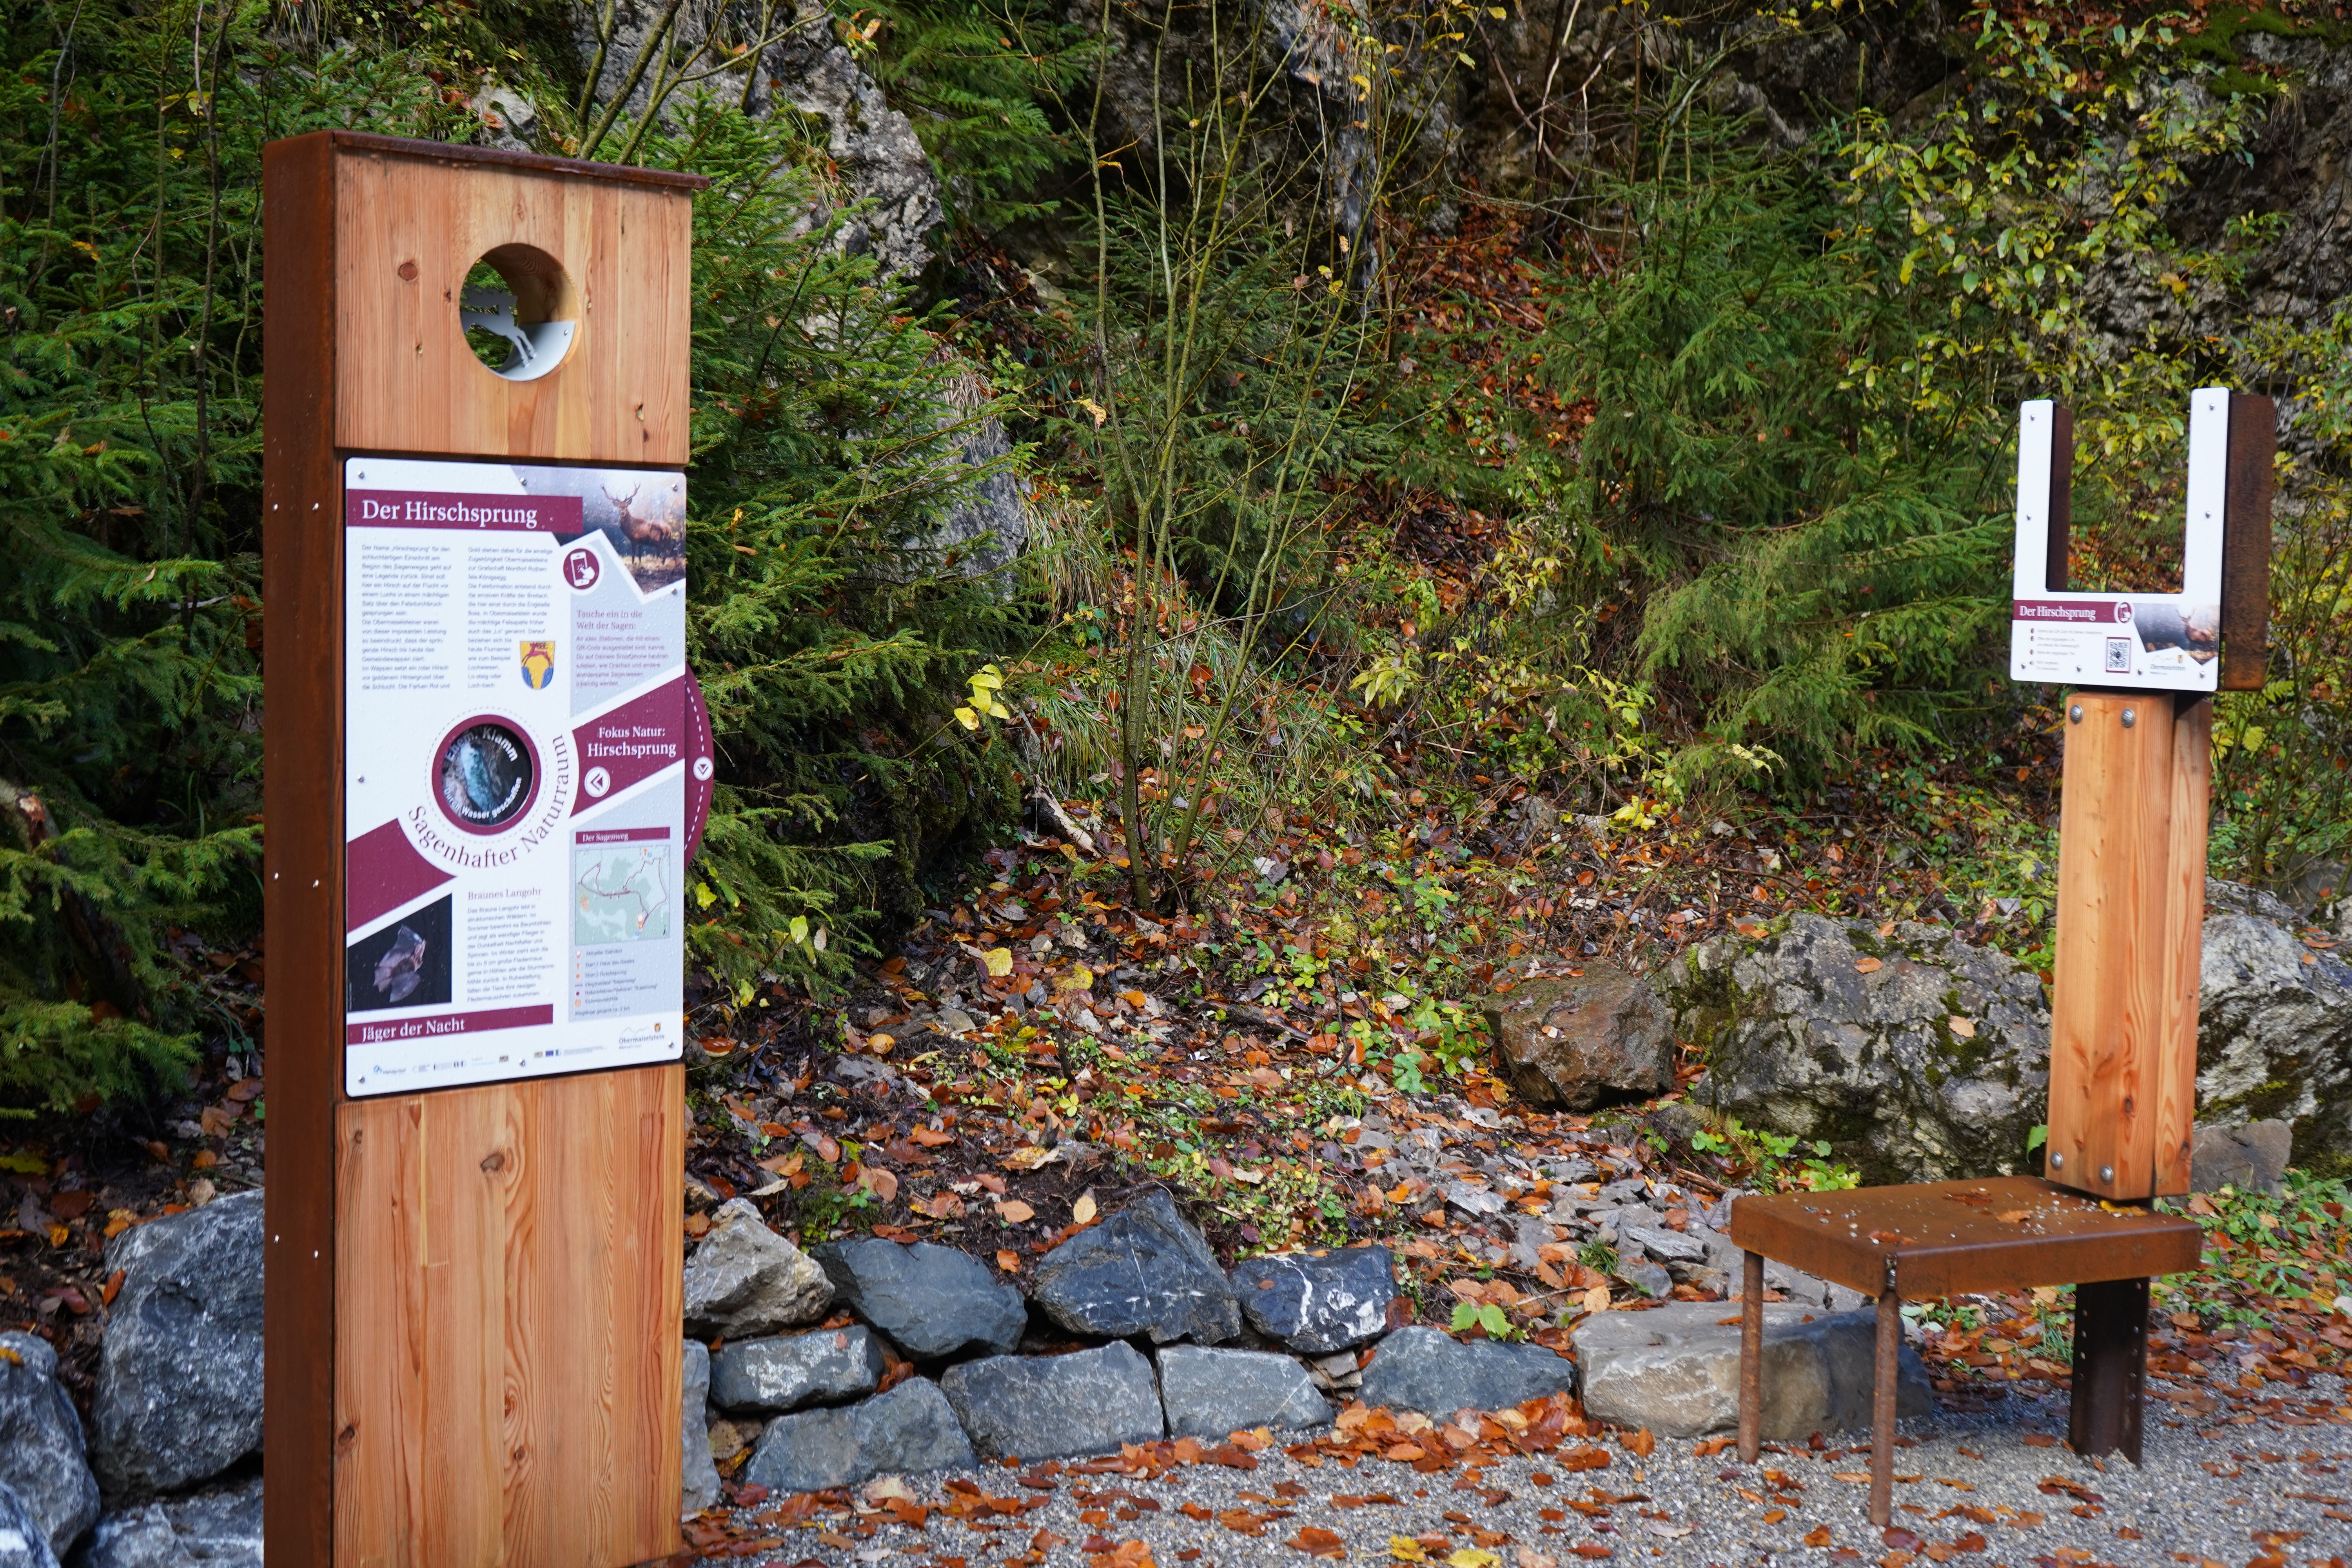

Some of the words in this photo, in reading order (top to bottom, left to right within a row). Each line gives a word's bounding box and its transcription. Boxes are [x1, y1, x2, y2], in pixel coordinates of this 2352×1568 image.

[362, 499, 400, 519] Der
[405, 501, 537, 529] Hirschsprung
[2020, 606, 2036, 616] Der
[2037, 606, 2096, 621] Hirschsprung
[599, 726, 630, 739] Fokus
[632, 726, 665, 738] Natur:
[445, 731, 478, 762] Ehem.
[482, 727, 518, 762] Klamm
[587, 741, 677, 759] Hirschsprung
[409, 806, 518, 868] Sagenhafter
[520, 734, 568, 853] Naturraum
[444, 788, 461, 811] Durch
[461, 806, 490, 819] Wasser
[492, 777, 522, 818] geschaffen
[583, 833, 595, 842] Der
[596, 833, 628, 842] Sagenweg
[468, 891, 503, 900] Braunes
[506, 887, 540, 898] Langohr
[362, 1025, 396, 1042] Jäger
[400, 1022, 422, 1037] der
[426, 1017, 465, 1034] Nacht
[619, 1034, 664, 1044] Obermaiselstein
